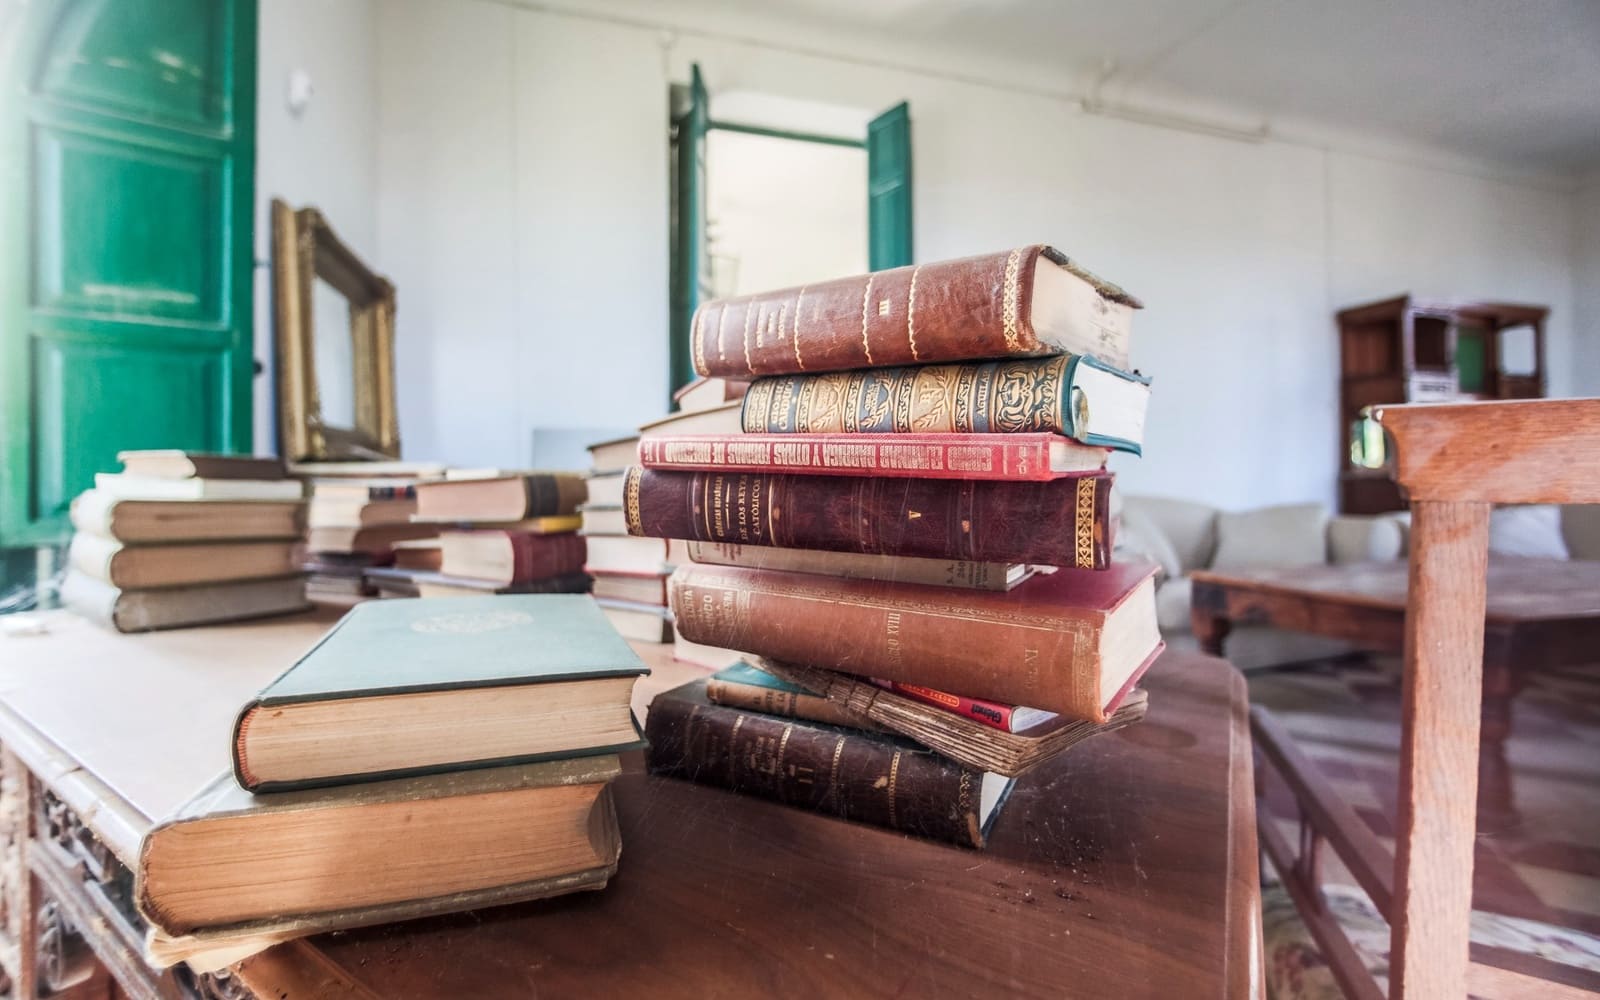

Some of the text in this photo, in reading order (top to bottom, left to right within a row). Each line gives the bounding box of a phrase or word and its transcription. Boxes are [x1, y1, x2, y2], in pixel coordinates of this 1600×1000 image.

[711, 443, 725, 465] DE
[728, 443, 770, 466] FORMAS
[773, 444, 810, 467] OTRAS
[812, 444, 821, 467] Y
[823, 444, 876, 469] BARRIGA
[880, 445, 943, 470] ELIMINAR
[948, 446, 992, 471] COMO
[738, 506, 746, 525] LOS
